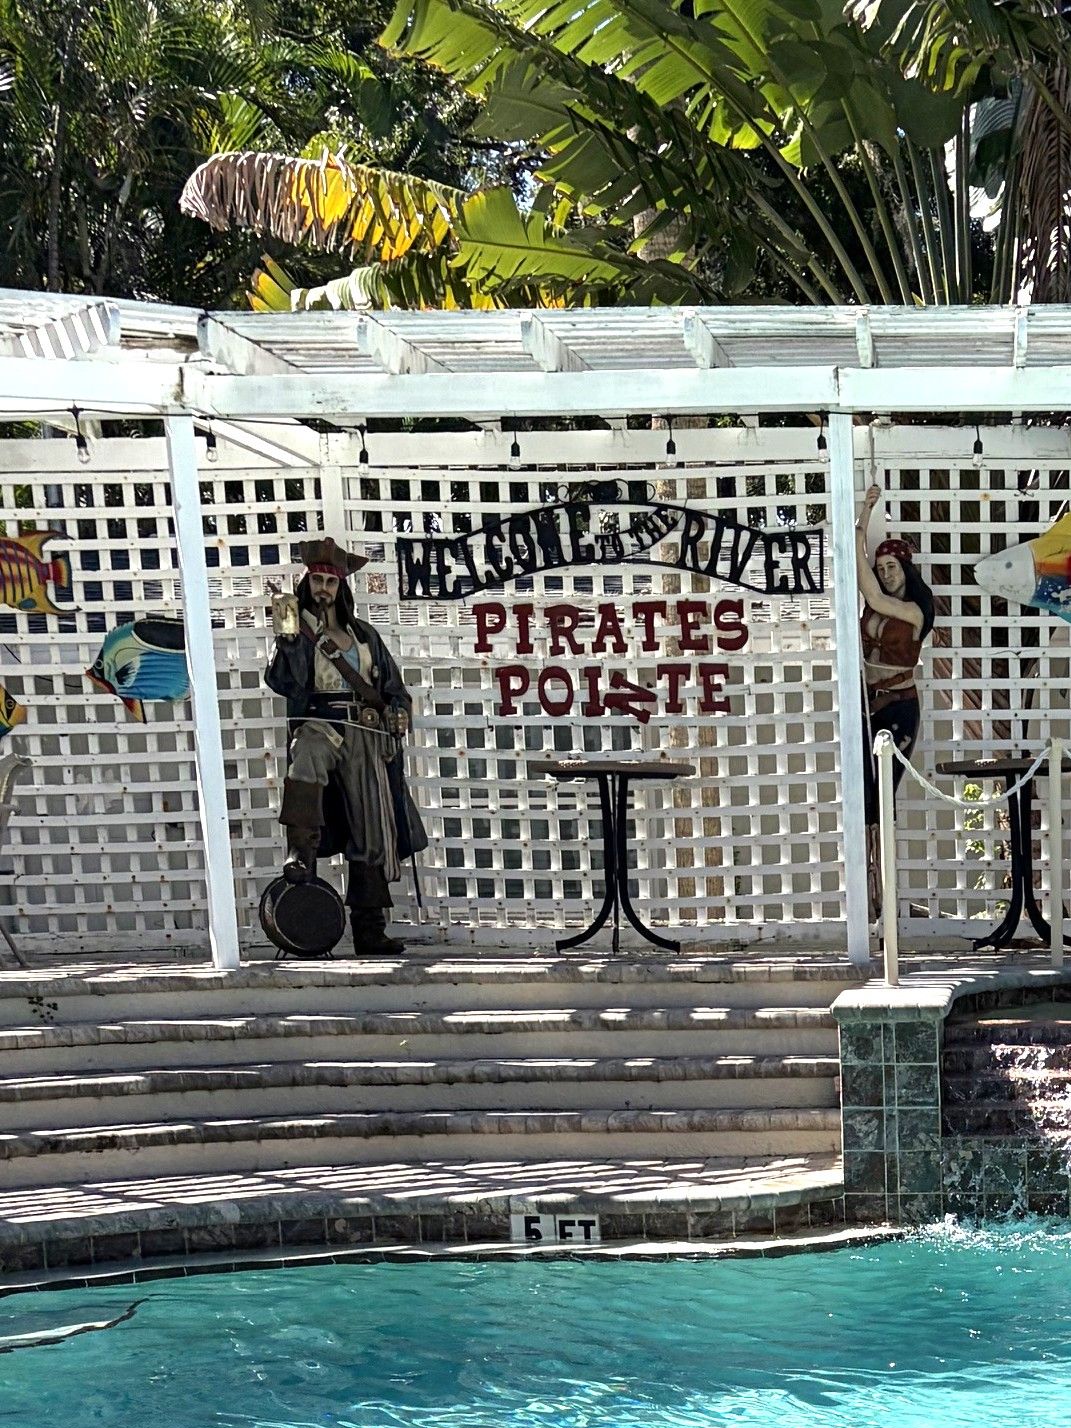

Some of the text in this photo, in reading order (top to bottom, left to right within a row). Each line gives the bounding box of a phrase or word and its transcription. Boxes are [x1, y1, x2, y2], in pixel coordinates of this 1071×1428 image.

[403, 503, 821, 598] WELCOME TO THE RIVER
[472, 599, 749, 657] PIRATES
[495, 662, 732, 724] POINTE
[524, 1216, 596, 1240] 5 FT
